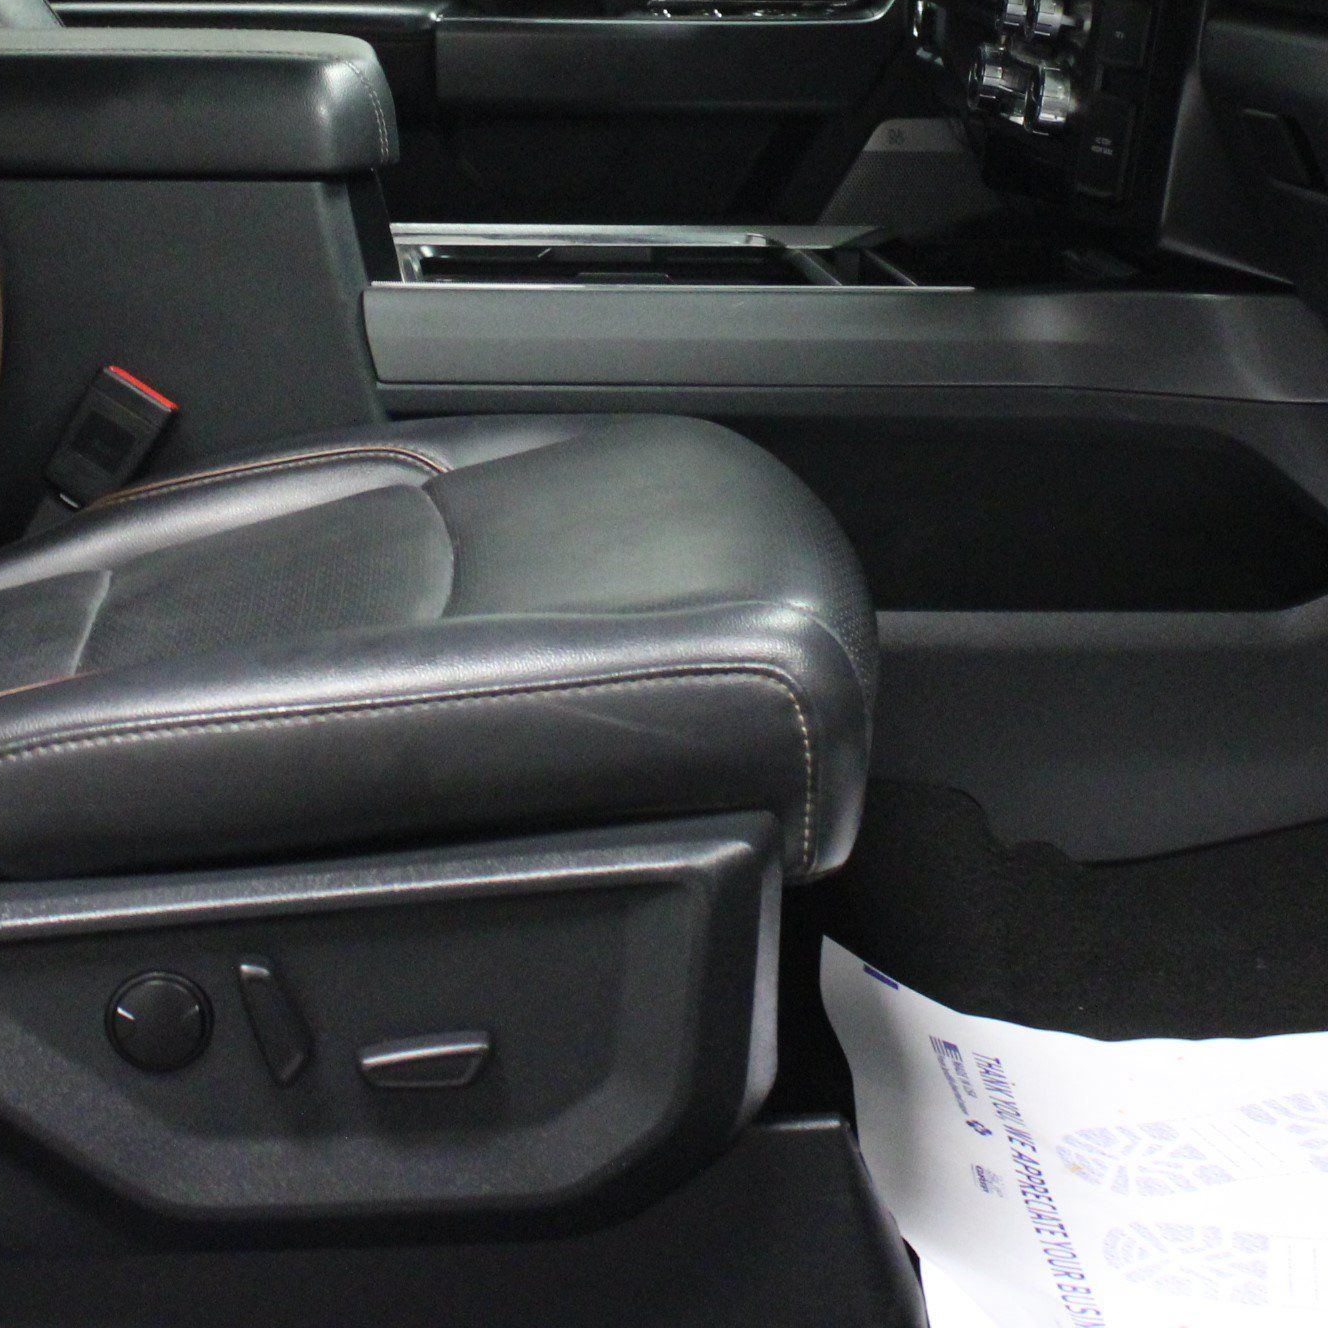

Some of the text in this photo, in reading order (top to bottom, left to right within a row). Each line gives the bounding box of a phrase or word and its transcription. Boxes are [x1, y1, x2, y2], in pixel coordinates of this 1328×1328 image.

[972, 1052, 1015, 1099] THANK
[1003, 1124, 1037, 1153] WE
[1010, 1147, 1069, 1238] APPRECIATE
[1040, 1240, 1086, 1280] YOUR
